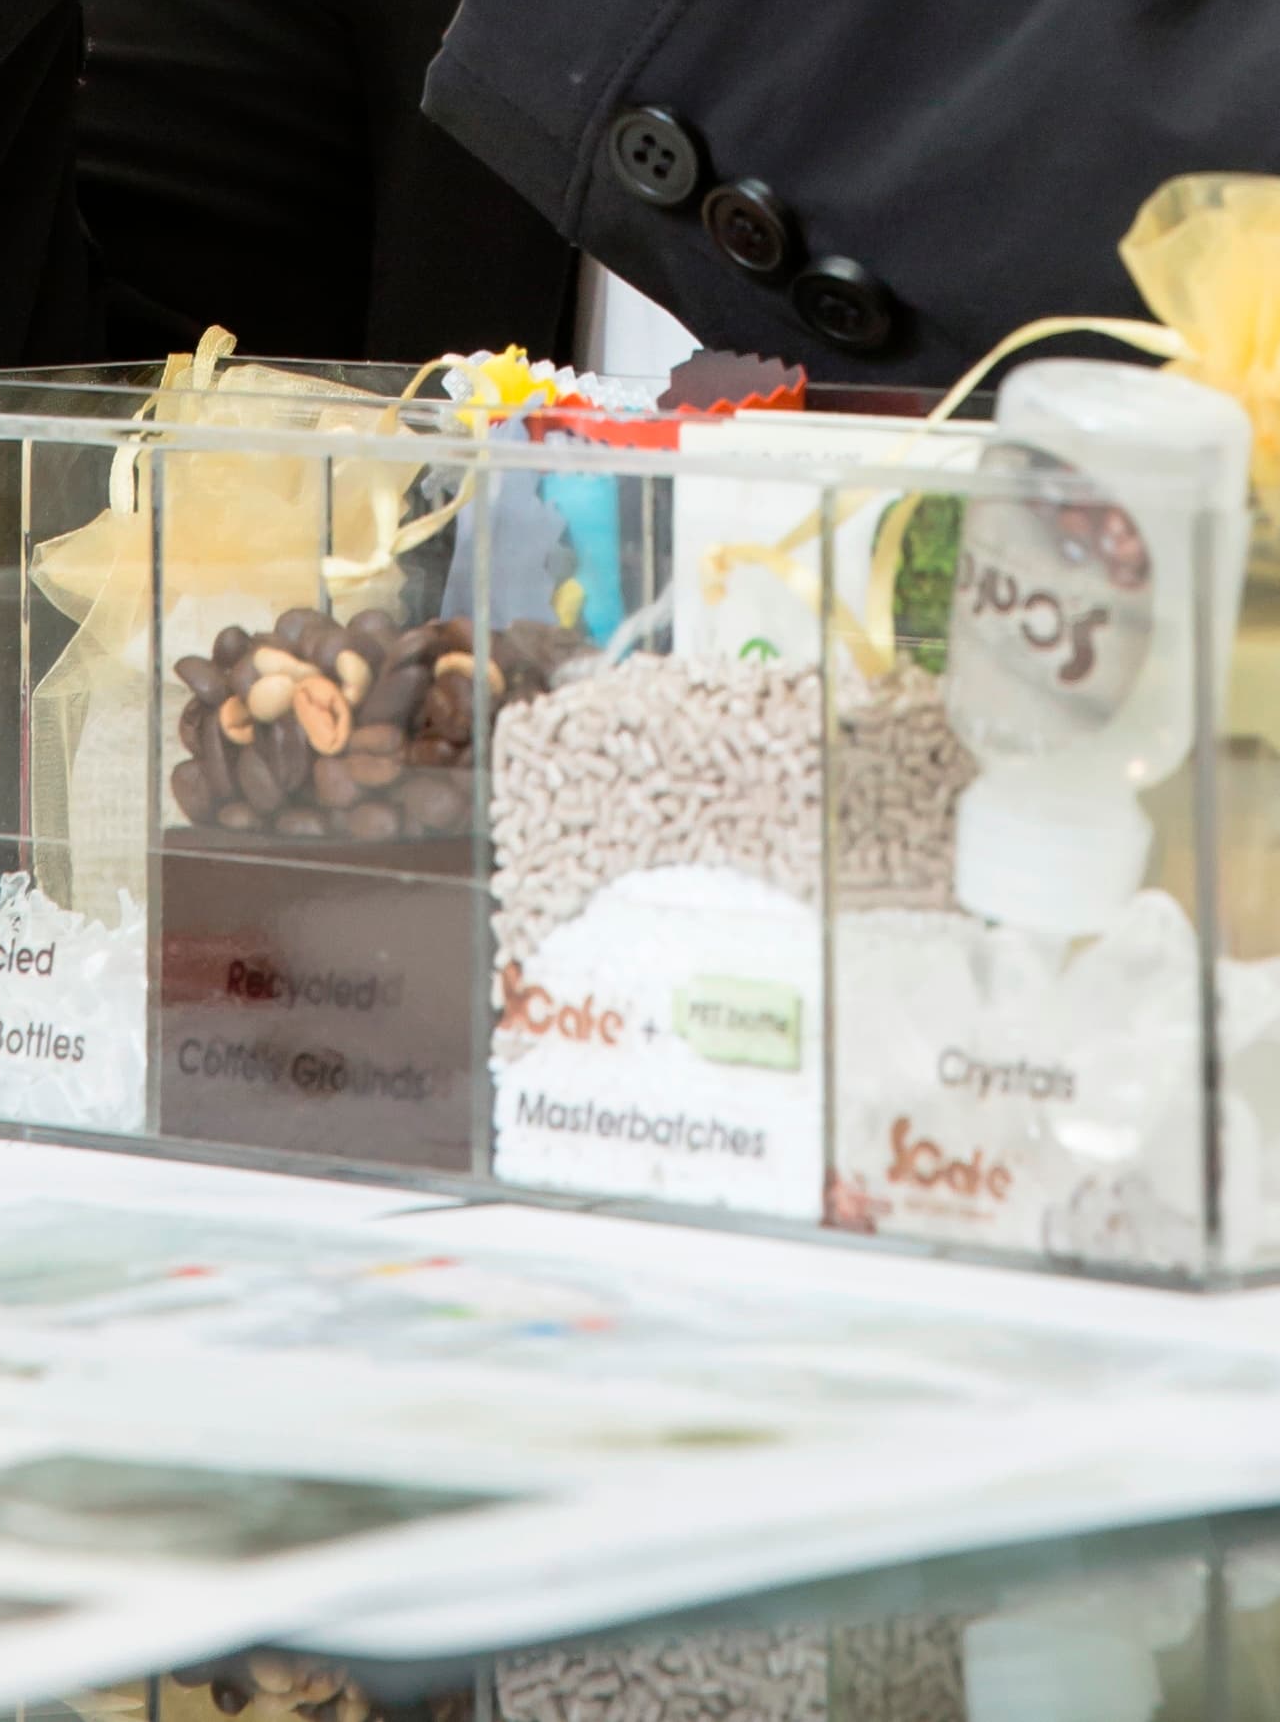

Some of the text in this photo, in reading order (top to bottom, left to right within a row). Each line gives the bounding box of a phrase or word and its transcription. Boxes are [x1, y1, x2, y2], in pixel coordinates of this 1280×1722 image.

[226, 959, 378, 1010] Recycled
[938, 1047, 1076, 1102] Crystals
[515, 1090, 768, 1159] Masterbatches
